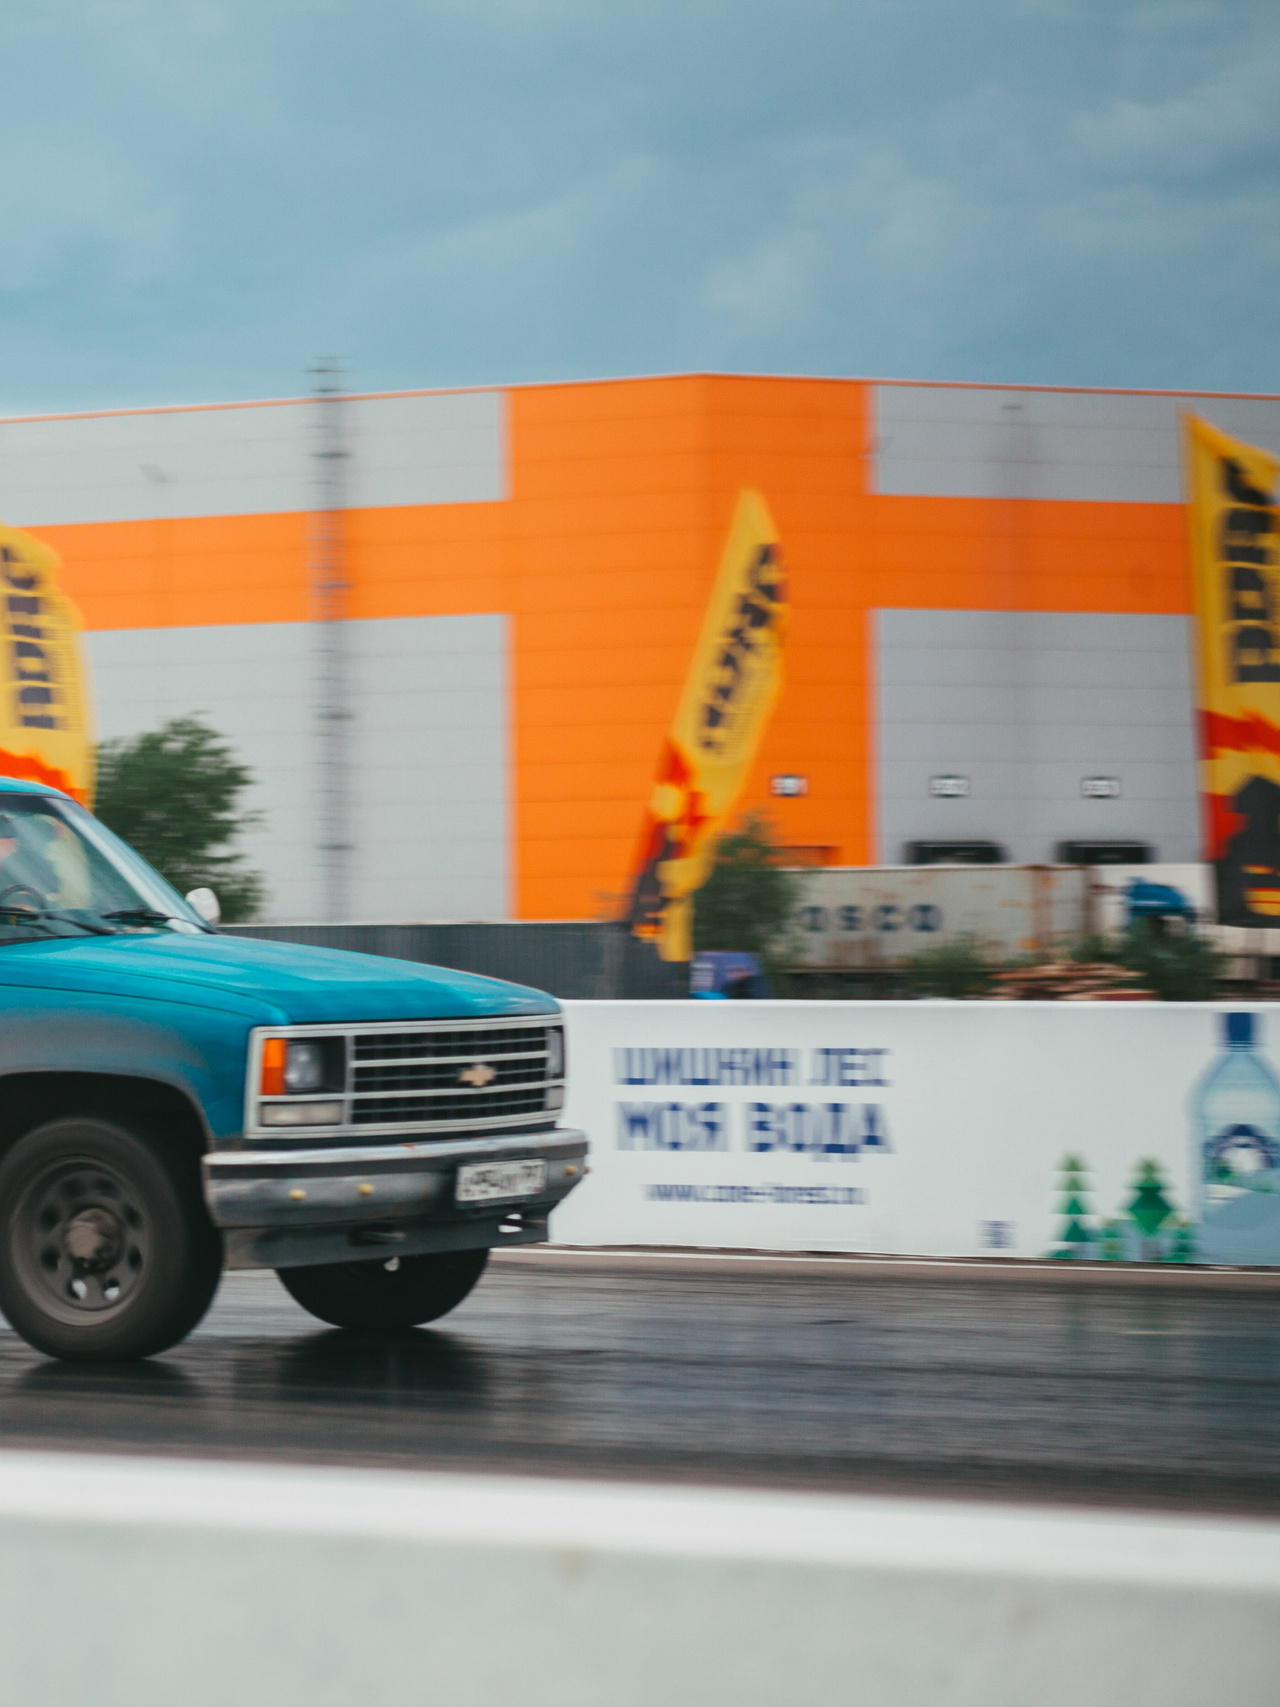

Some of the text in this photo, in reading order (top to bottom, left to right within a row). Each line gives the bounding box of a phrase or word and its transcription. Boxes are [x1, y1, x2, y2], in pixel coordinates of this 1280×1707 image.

[812, 1048, 891, 1087] ЛЕС
[618, 1102, 891, 1160] МОЯ ВОДА
